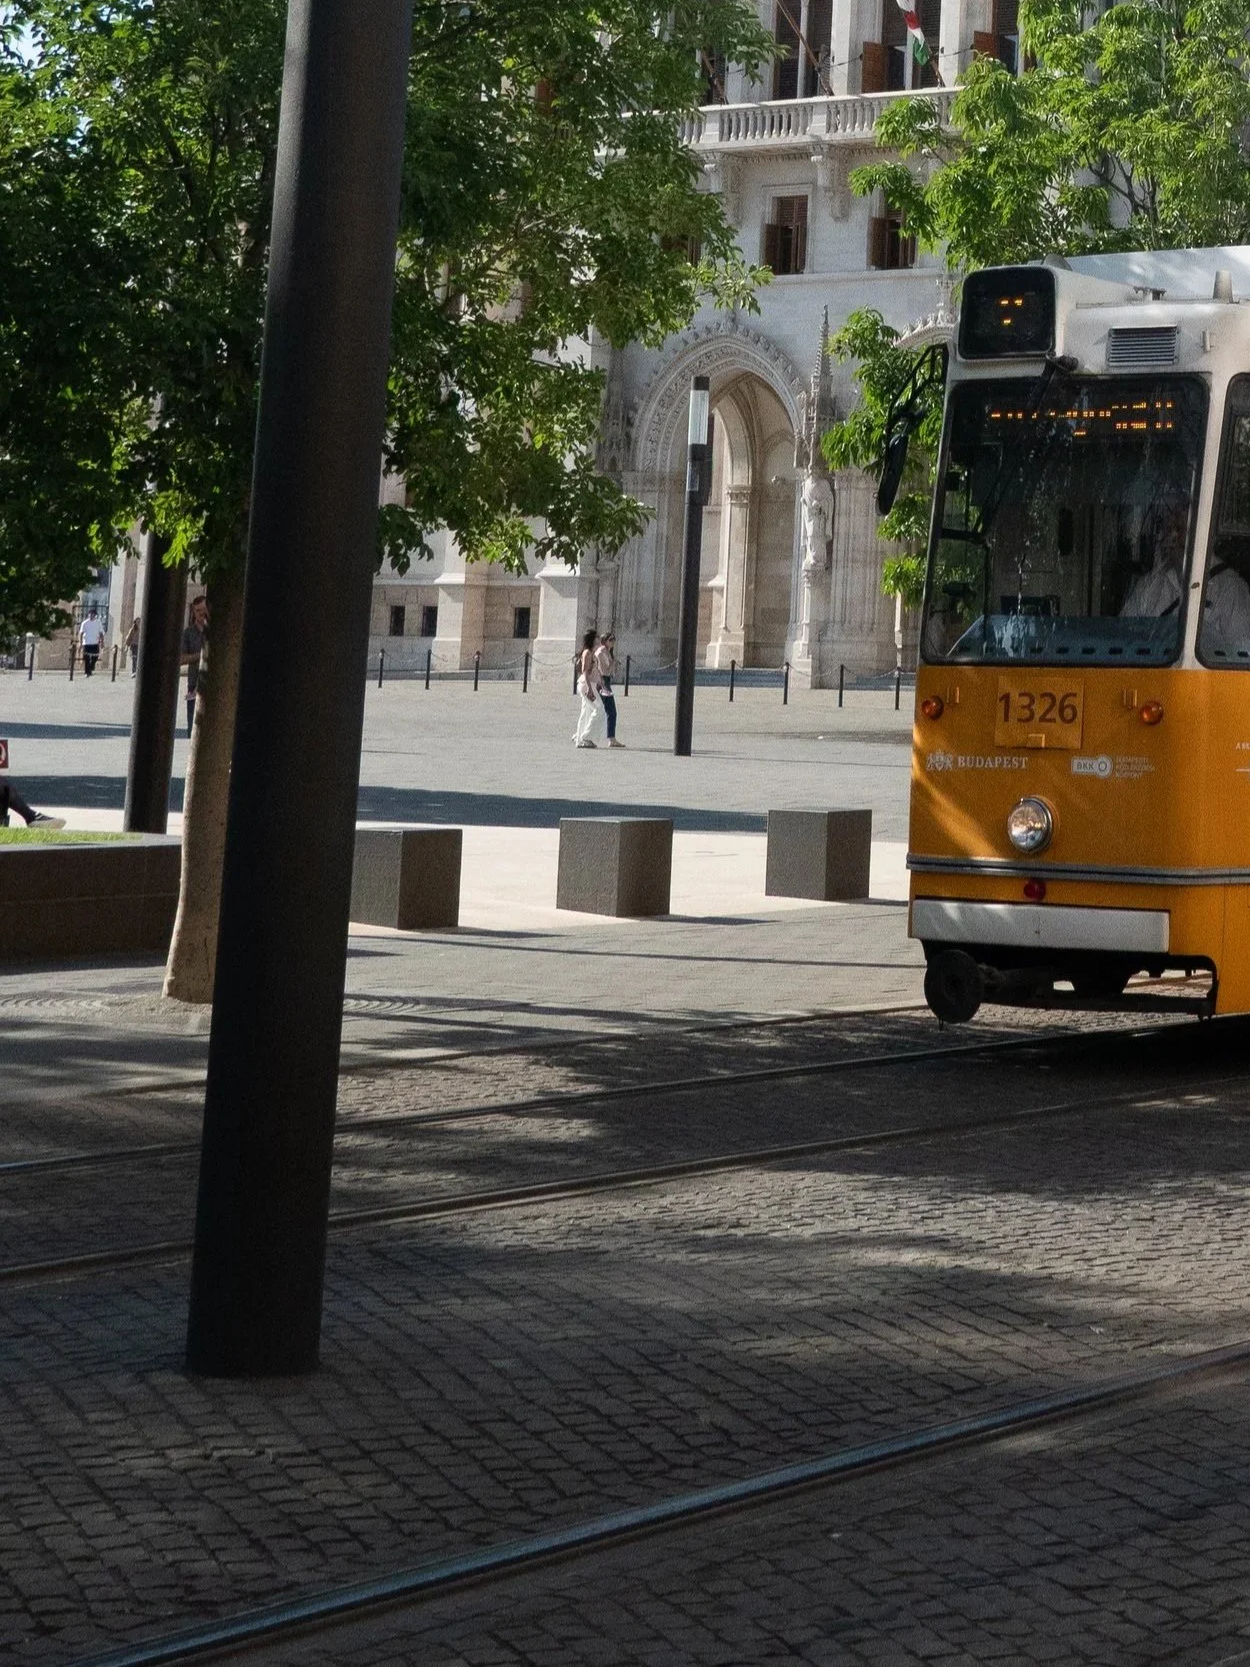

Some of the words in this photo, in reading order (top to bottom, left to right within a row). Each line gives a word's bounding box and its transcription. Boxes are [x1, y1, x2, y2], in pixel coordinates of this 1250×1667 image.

[999, 691, 1078, 724] 1326
[957, 755, 1029, 769] BUDAPEST
[1076, 761, 1095, 771] BKK
